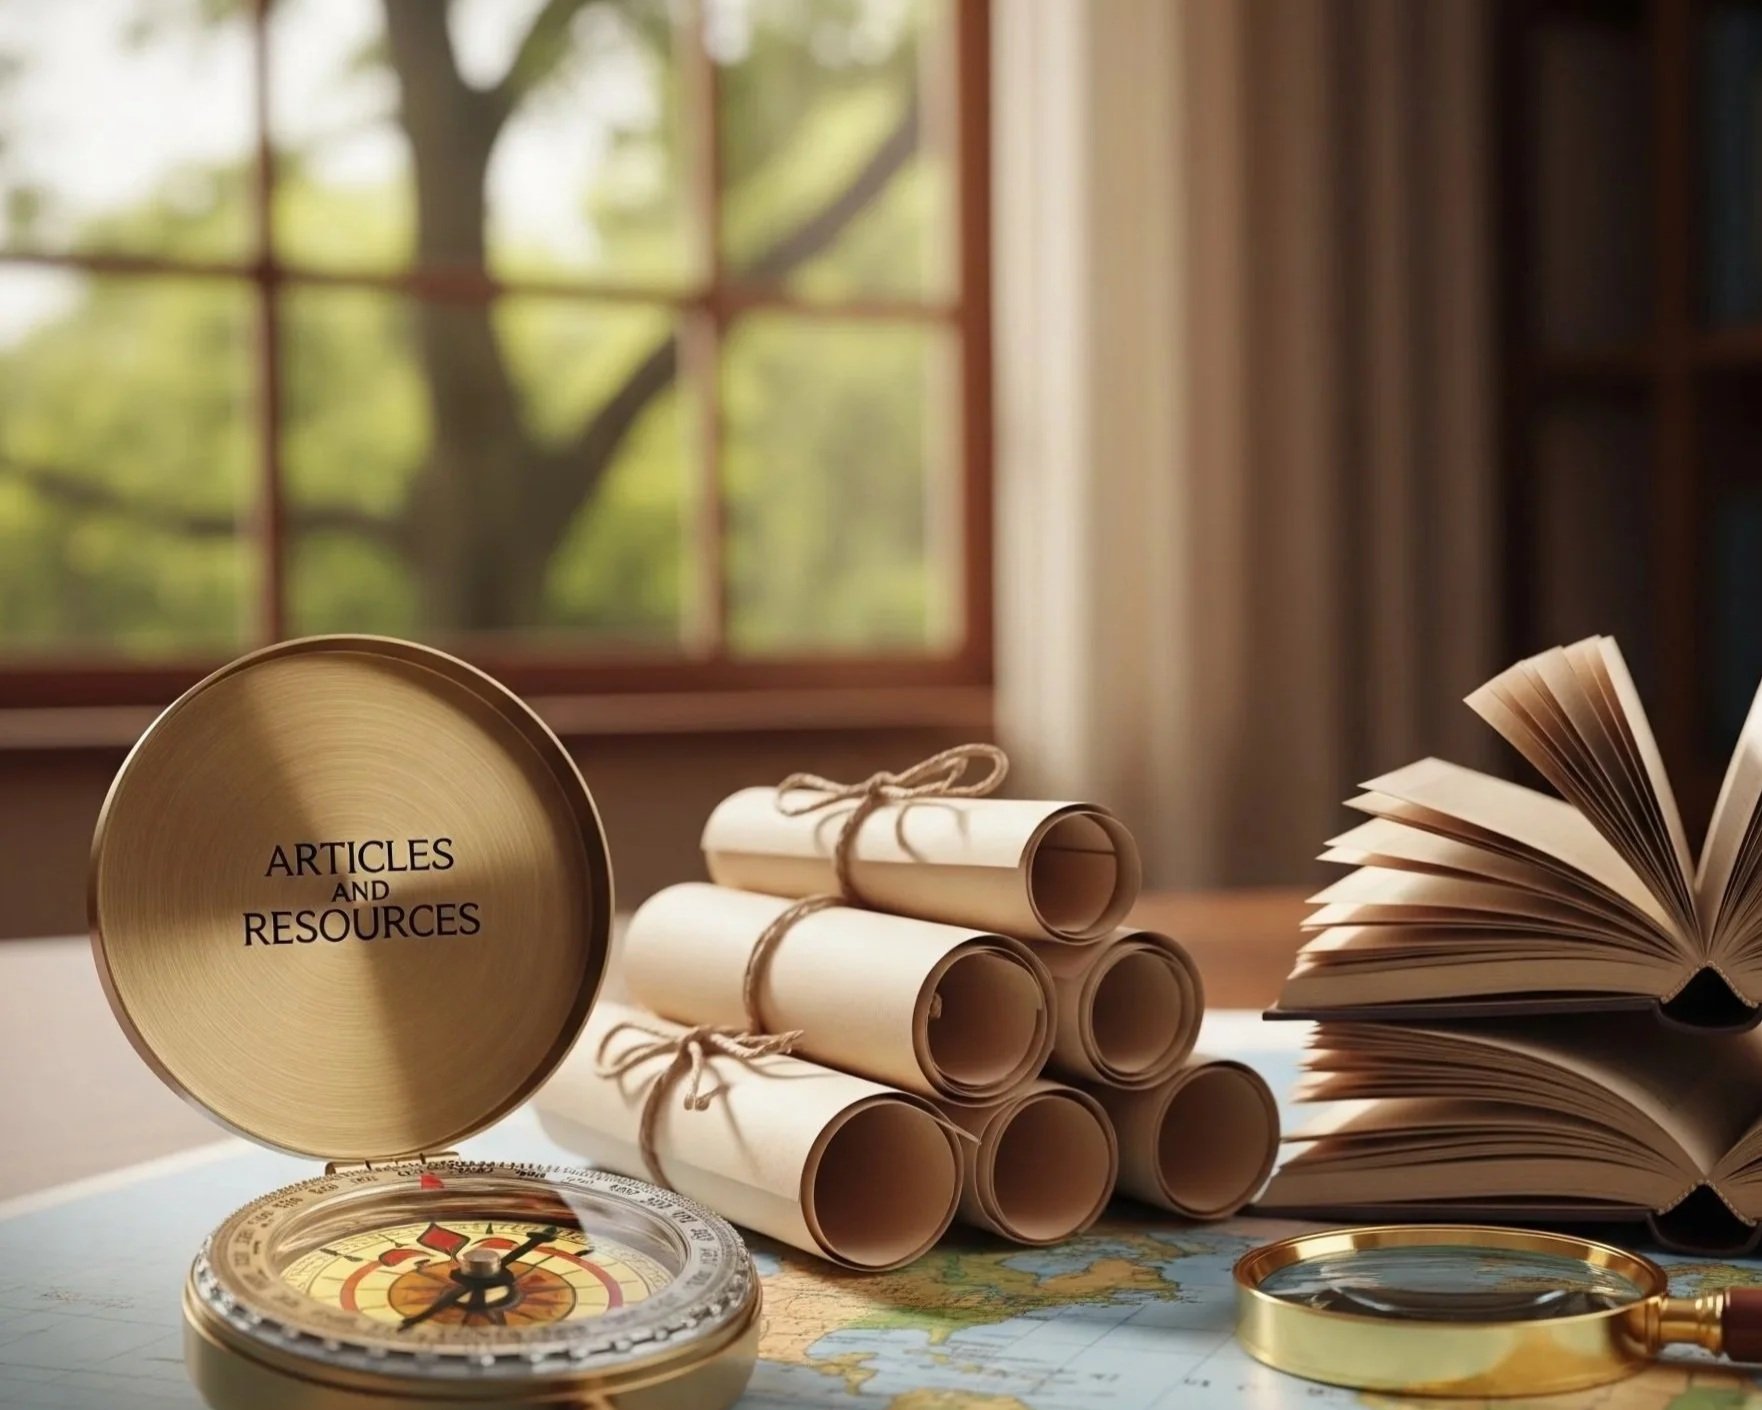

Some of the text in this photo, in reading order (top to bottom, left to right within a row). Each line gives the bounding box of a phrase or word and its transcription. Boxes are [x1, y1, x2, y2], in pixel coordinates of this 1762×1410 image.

[264, 838, 454, 877] ARTICLES
[331, 880, 390, 903] AND
[243, 902, 480, 946] RESOURCES
